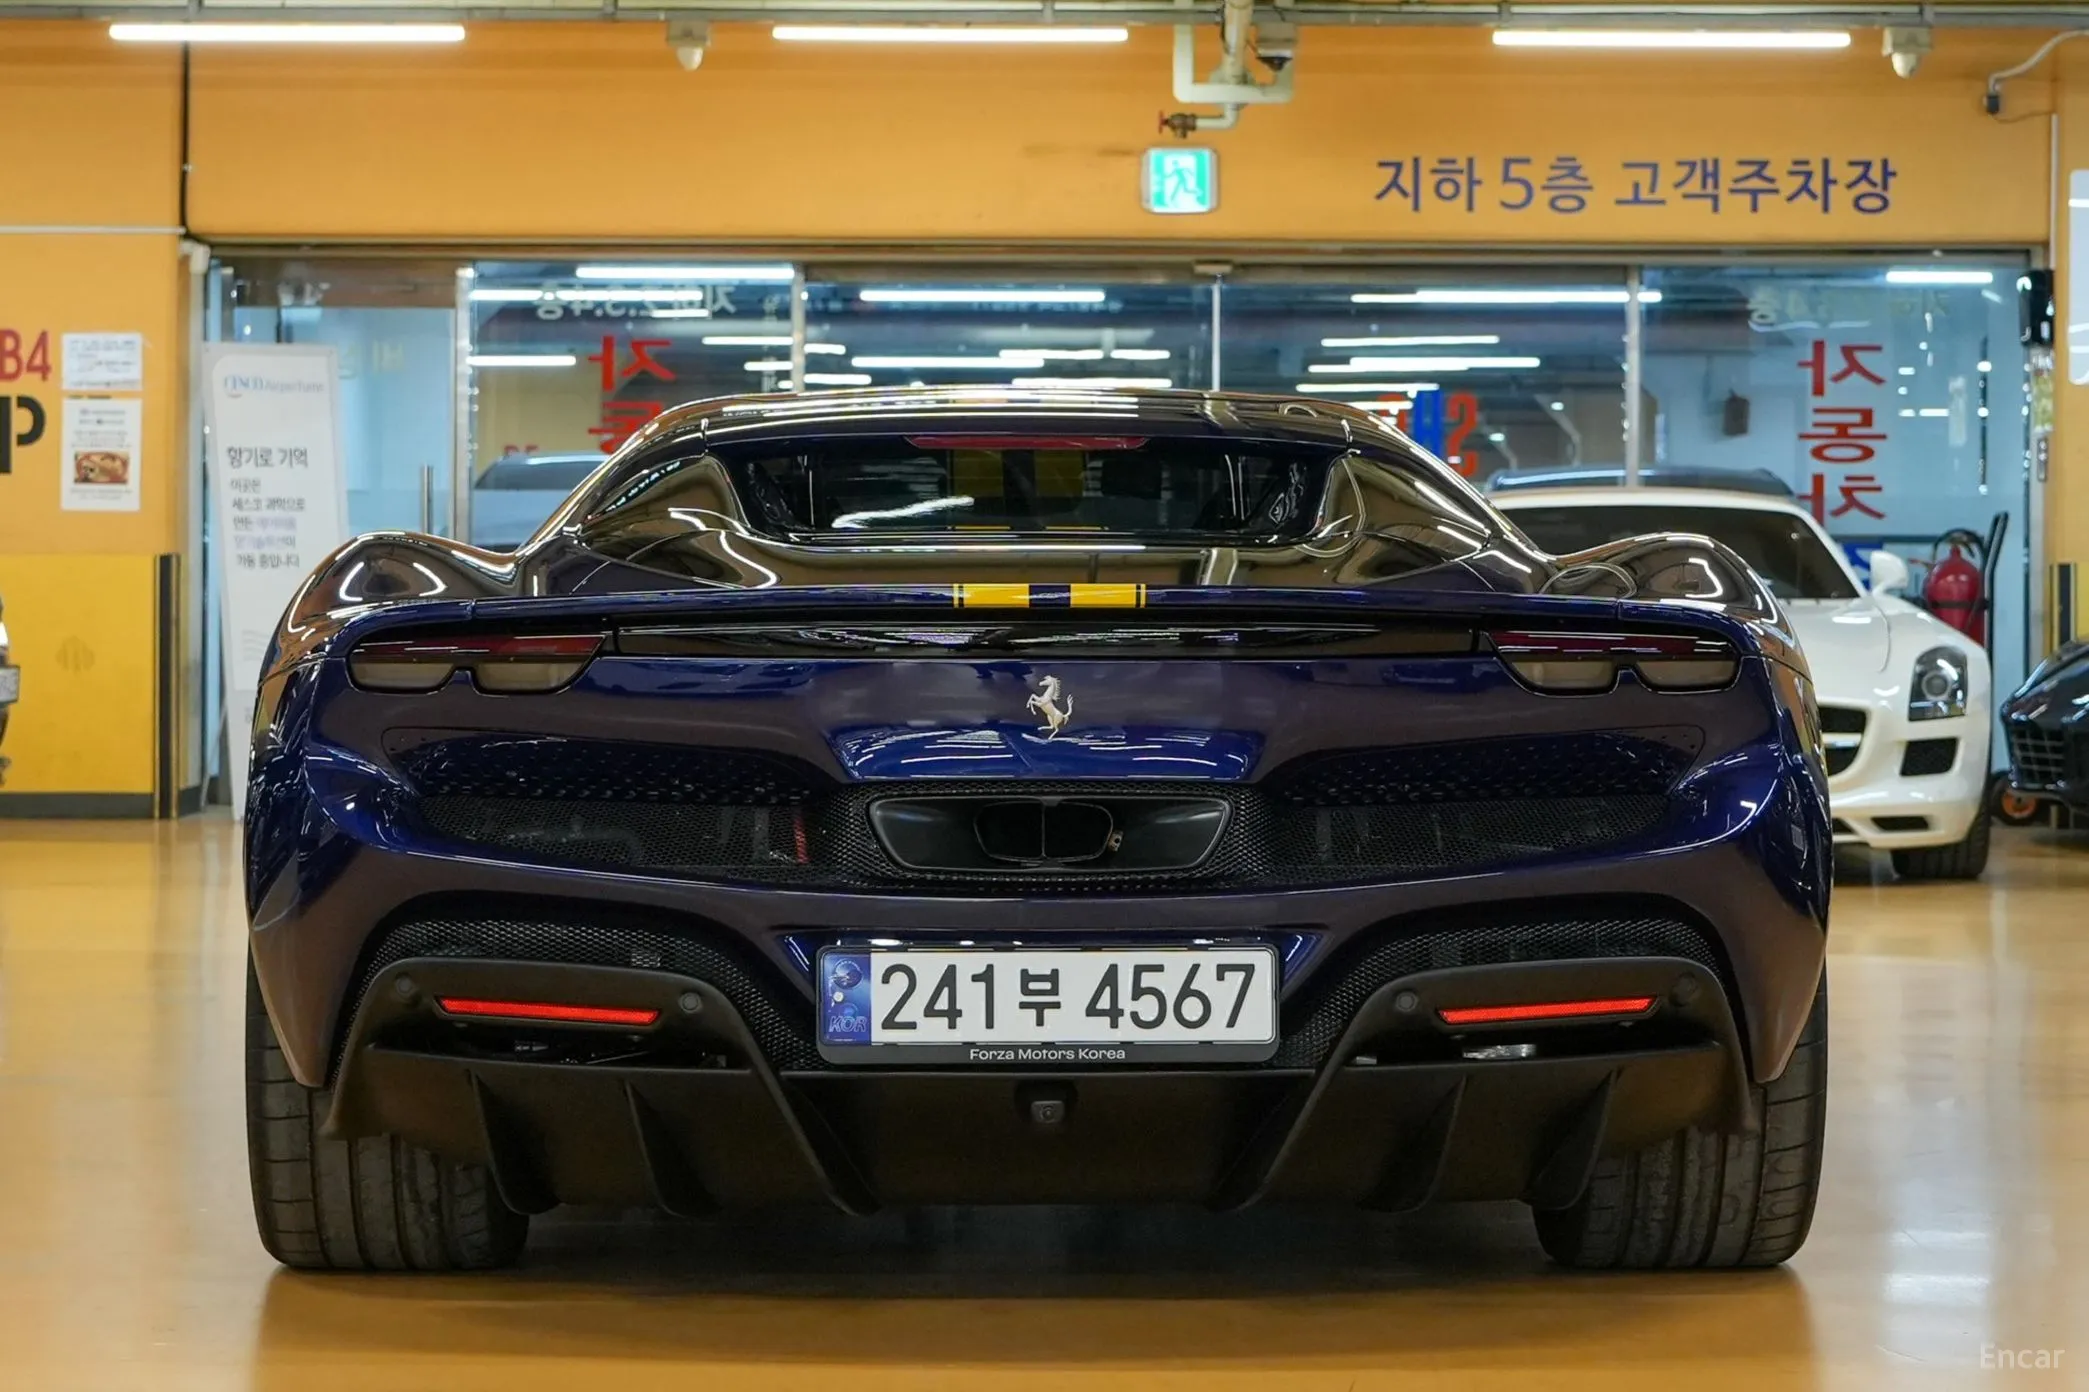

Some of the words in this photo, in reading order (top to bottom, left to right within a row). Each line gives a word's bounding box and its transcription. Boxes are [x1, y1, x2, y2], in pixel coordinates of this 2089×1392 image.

[1374, 156, 1483, 213] 지하
[1501, 156, 1593, 214] 5층
[1614, 157, 1897, 215] 고객주차장
[0, 328, 52, 382] B4
[0, 395, 46, 474] P
[227, 446, 273, 468] 향기로
[279, 447, 308, 468] 기억
[1085, 963, 1256, 1030] 4567
[829, 1016, 867, 1033] KOR
[969, 1048, 1015, 1060] Forza
[1018, 1048, 1075, 1060] Motors
[1078, 1048, 1126, 1060] Korea
